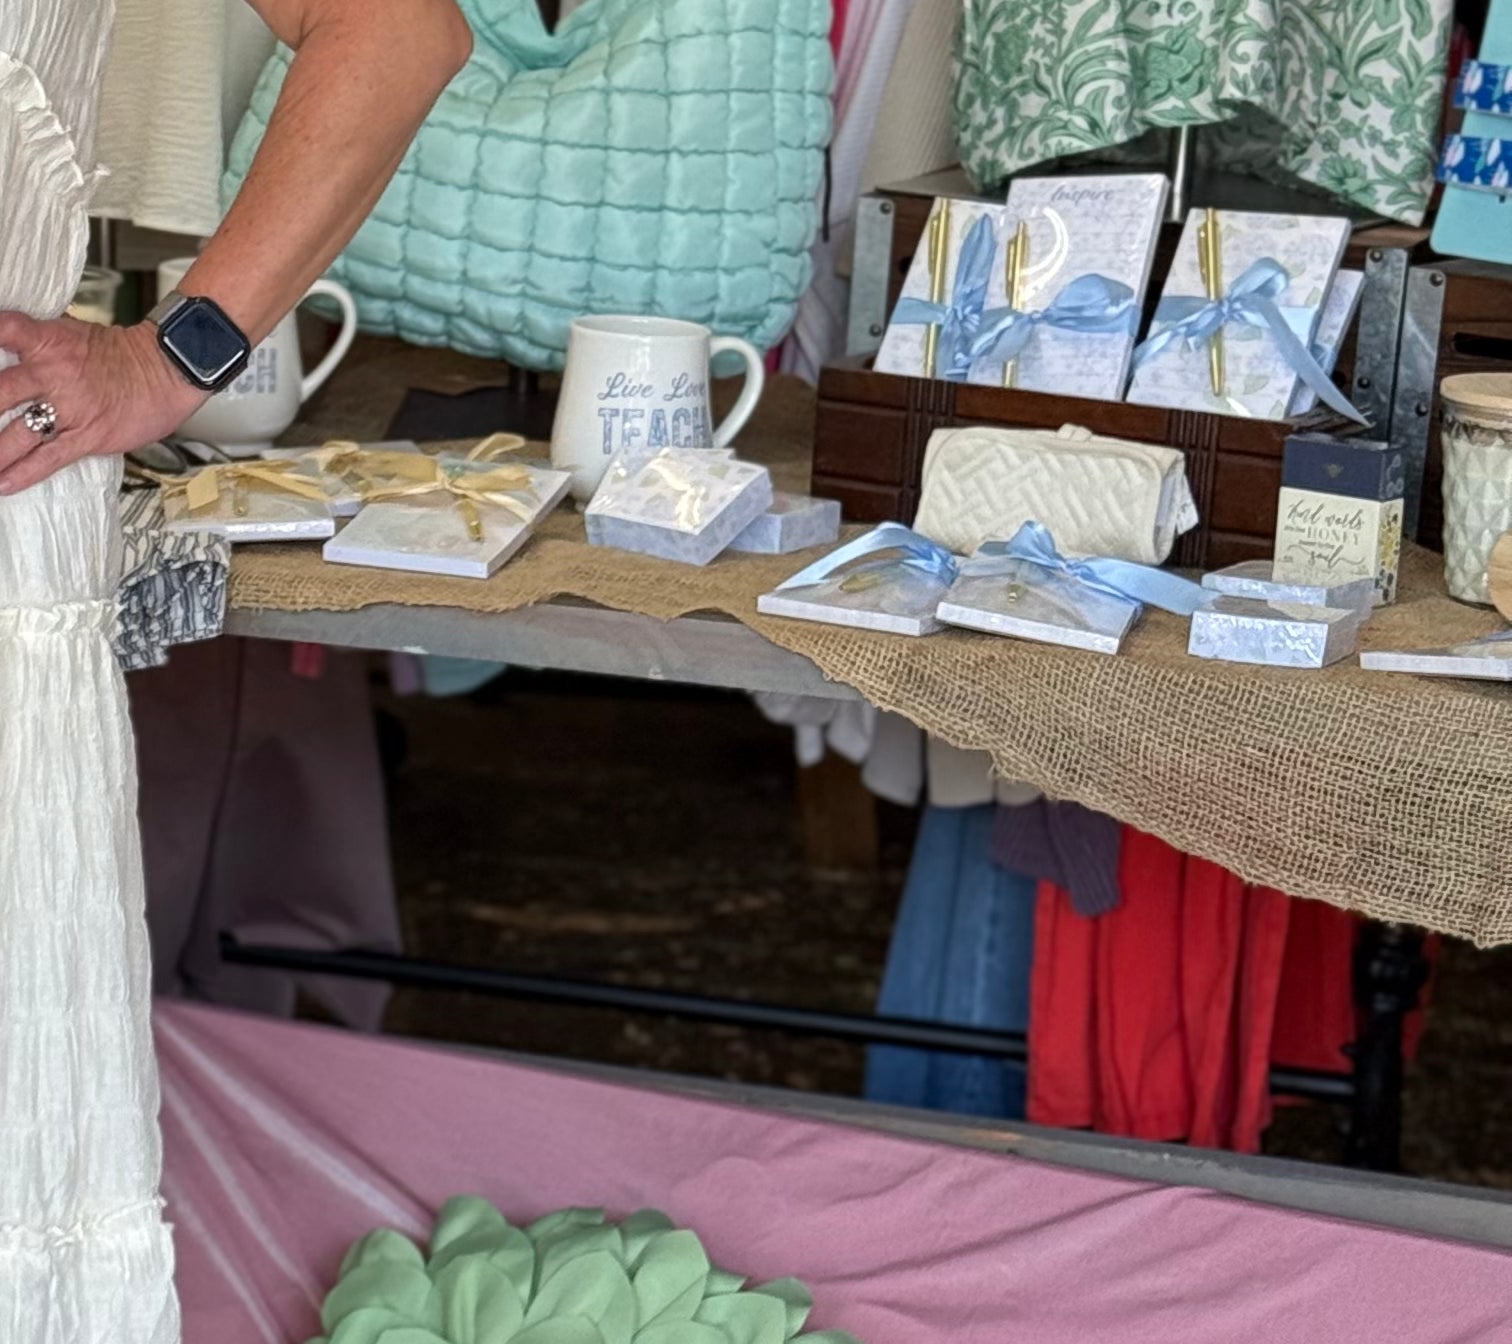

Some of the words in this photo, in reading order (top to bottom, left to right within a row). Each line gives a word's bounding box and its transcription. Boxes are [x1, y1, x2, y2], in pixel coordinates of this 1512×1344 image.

[596, 372, 655, 401] Live
[597, 407, 708, 455] TEACH
[1307, 526, 1359, 546] HONEY
